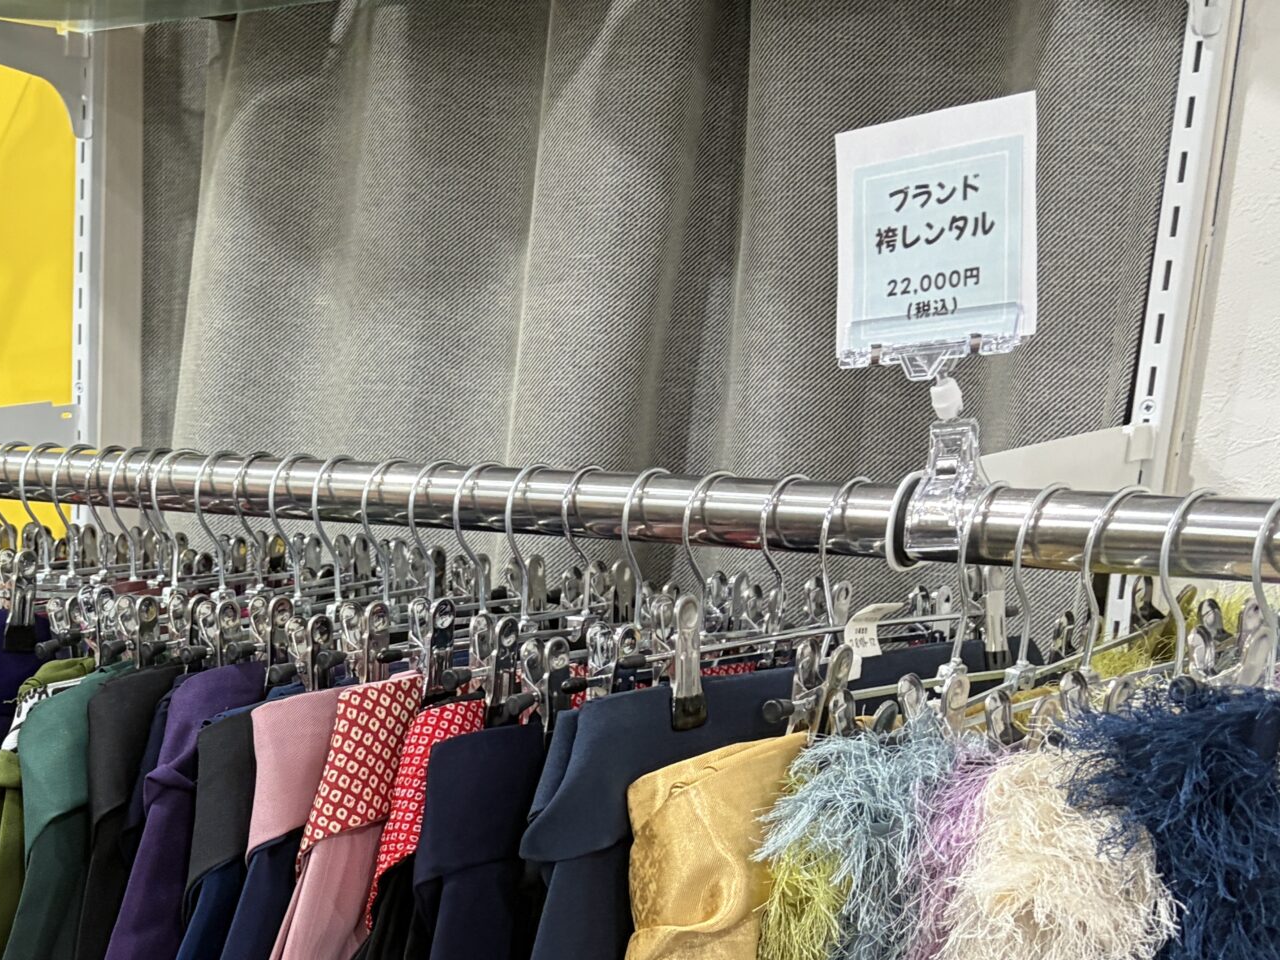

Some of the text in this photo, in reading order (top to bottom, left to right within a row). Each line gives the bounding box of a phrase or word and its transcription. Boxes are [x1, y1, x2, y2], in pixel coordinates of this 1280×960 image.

[889, 174, 980, 212] ブランド
[875, 211, 995, 254] 袴レンタル
[886, 267, 980, 297] 22,000円
[906, 297, 958, 320] (税込)
